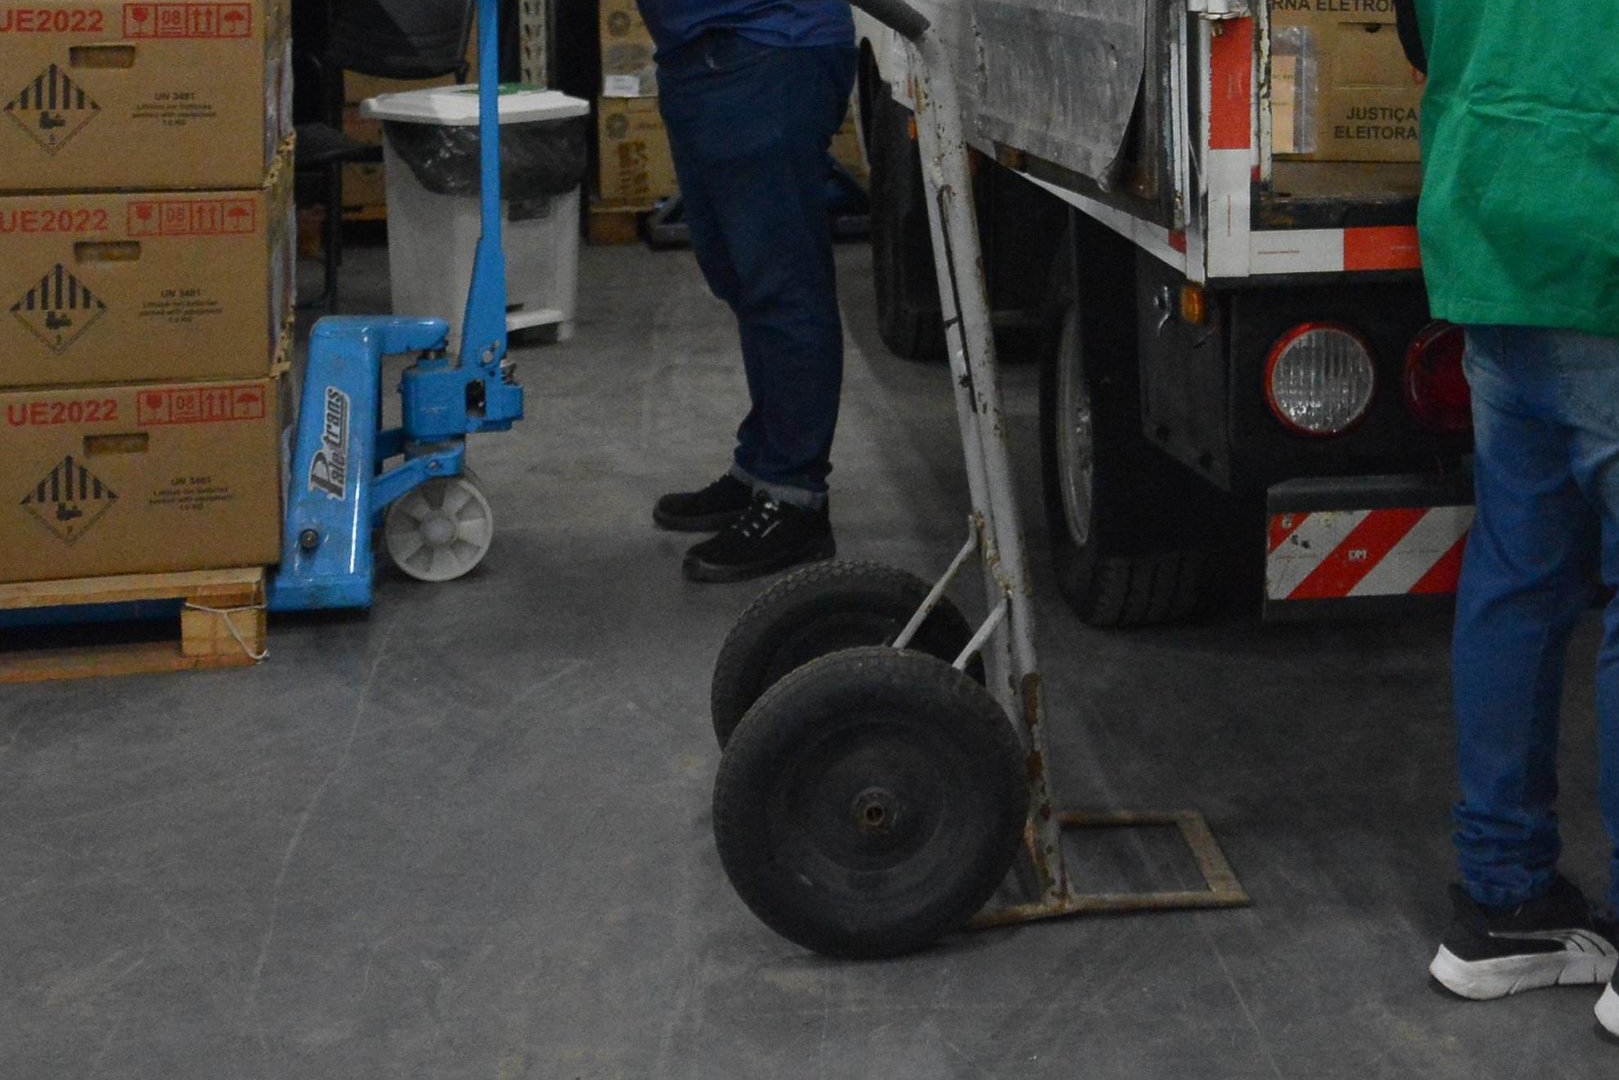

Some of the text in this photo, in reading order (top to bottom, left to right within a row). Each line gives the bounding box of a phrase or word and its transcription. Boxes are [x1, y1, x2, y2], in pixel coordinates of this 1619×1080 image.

[1346, 107, 1417, 123] JUSTIÇA
[1334, 126, 1418, 140] ELEITORA
[7, 400, 118, 427] UE2022
